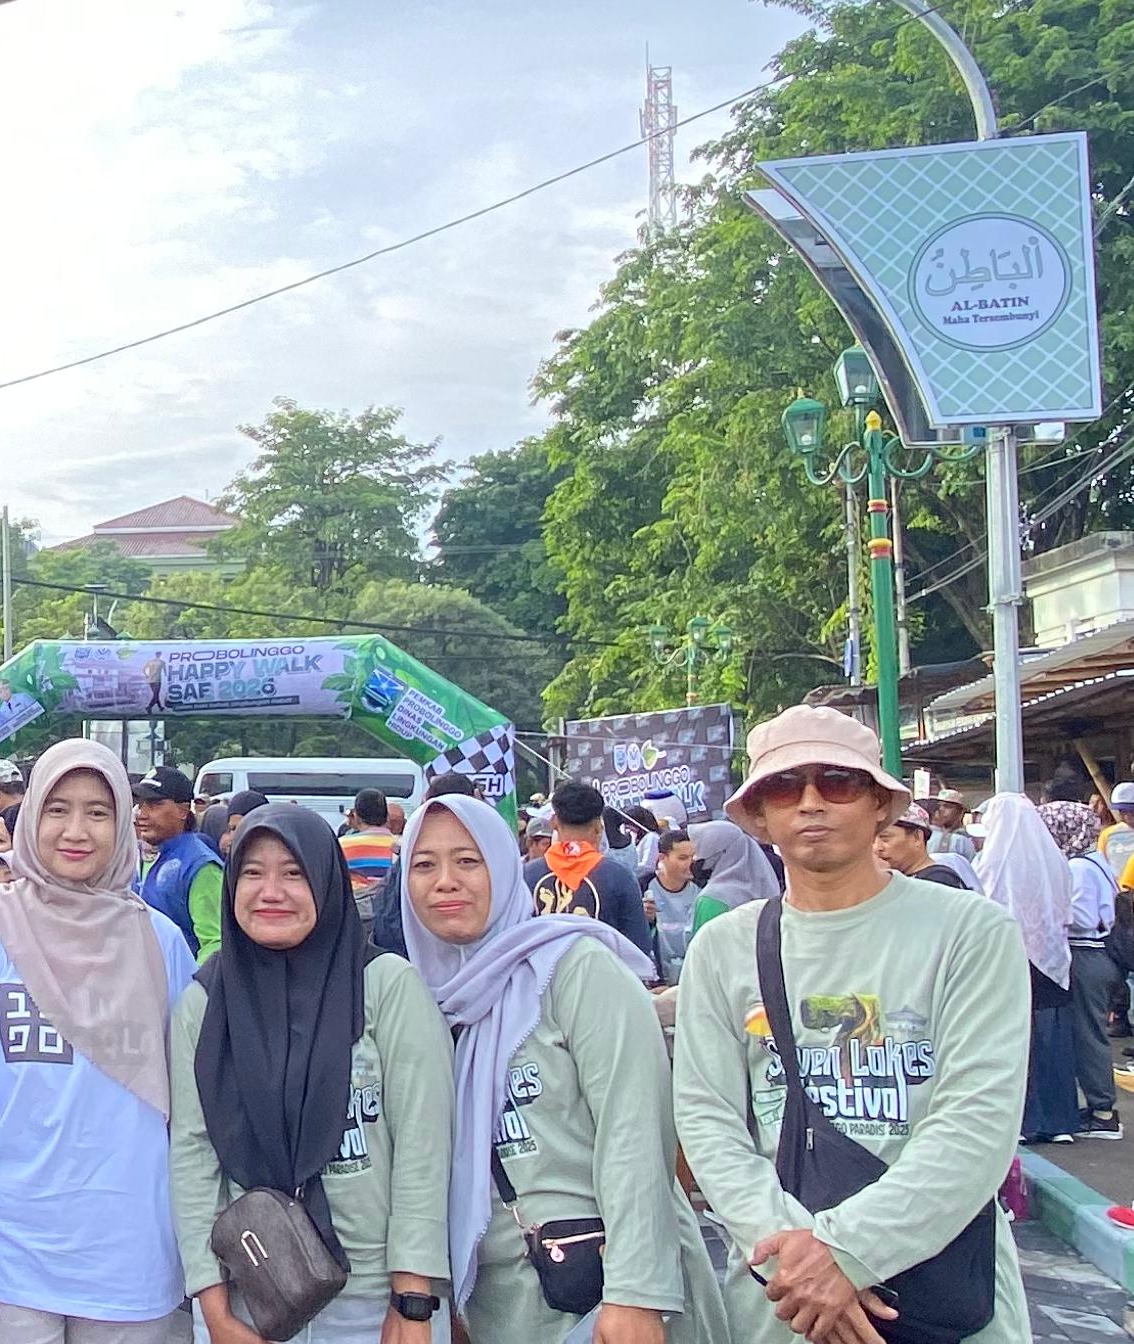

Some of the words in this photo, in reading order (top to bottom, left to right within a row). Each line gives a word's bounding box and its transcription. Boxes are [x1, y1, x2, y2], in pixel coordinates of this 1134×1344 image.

[951, 296, 1029, 312] AL-BATIN
[943, 315, 970, 325] Maha
[168, 645, 305, 663] PROBOLINGGO
[168, 662, 246, 682] HAPPY
[253, 655, 323, 677] WALK
[397, 705, 423, 724] DINAS
[408, 689, 444, 716] PEMKAB
[391, 712, 446, 752] LINGKUNGAN
[403, 697, 462, 740] PROBOLINGGO
[602, 765, 689, 797] PROBOLINGGO
[766, 1037, 842, 1079] Sven
[850, 1036, 935, 1078] Lakes
[888, 1123, 910, 1136] 2025
